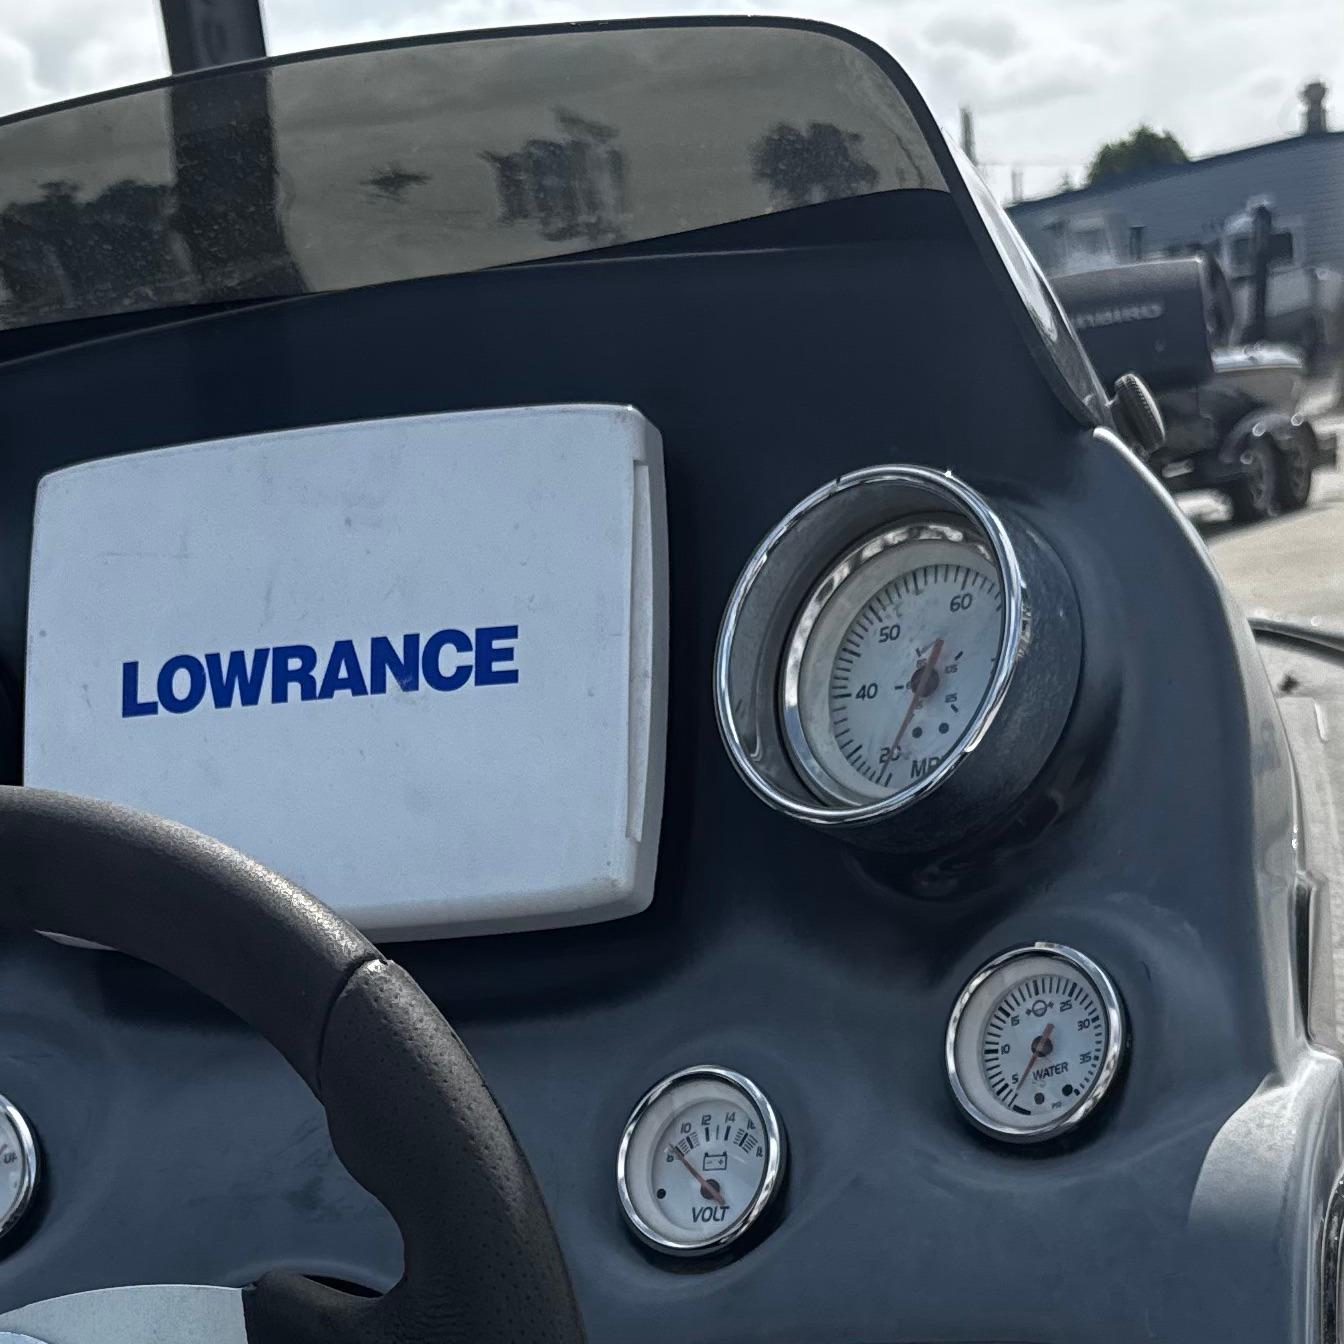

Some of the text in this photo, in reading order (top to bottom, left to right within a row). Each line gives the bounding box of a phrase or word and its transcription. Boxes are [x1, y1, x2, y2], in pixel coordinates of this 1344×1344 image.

[950, 593, 973, 612] 60
[879, 624, 901, 643] 50
[122, 625, 519, 718] LOWRANCE
[856, 682, 878, 700] 40
[1059, 1000, 1072, 1012] 25
[1011, 1015, 1020, 1027] 15
[1078, 1018, 1091, 1031] 30
[1001, 1044, 1010, 1055] 10
[1080, 1052, 1092, 1064] 35
[1032, 1062, 1069, 1080] WATER
[1012, 1074, 1019, 1084] 5
[701, 1115, 712, 1126] 12
[725, 1112, 736, 1123] 14
[680, 1122, 692, 1134] 10
[692, 1206, 730, 1223] VOLT
